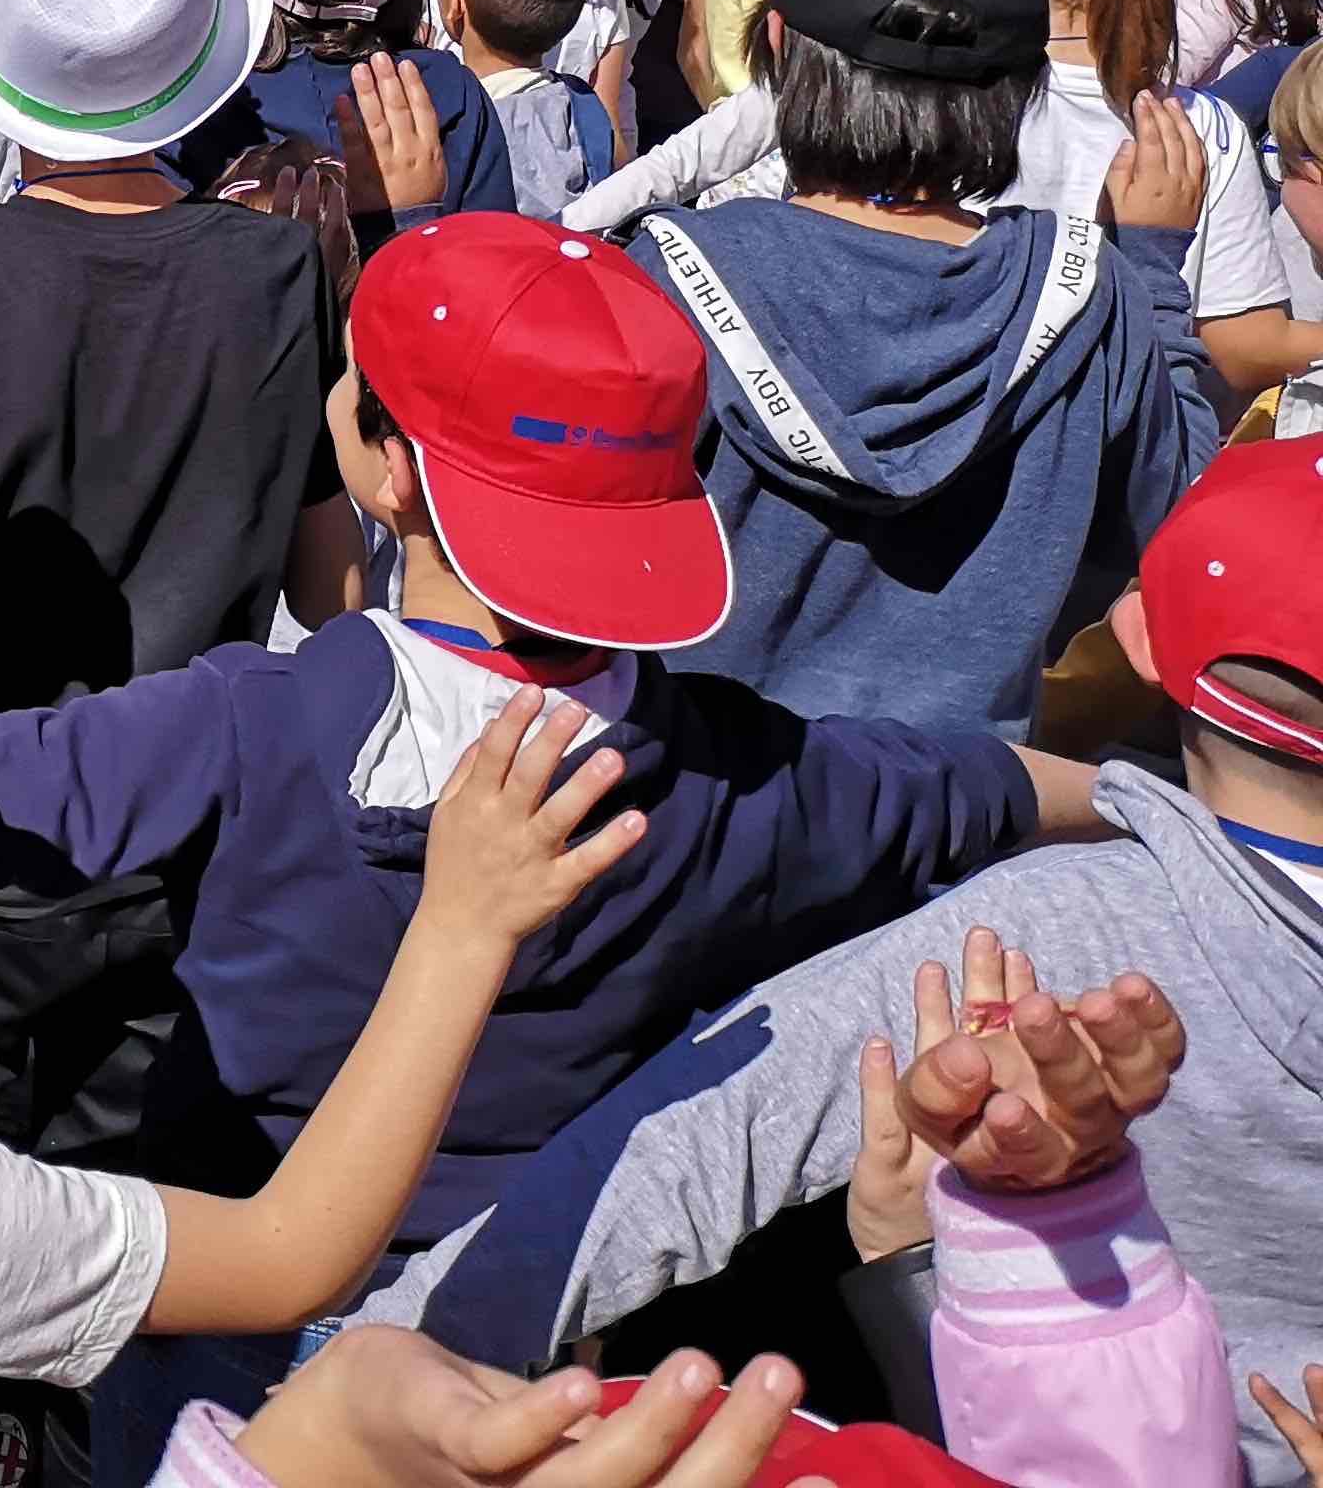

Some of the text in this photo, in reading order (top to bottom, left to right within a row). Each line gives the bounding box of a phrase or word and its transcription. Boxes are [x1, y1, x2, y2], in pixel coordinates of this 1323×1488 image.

[654, 230, 742, 335] ATHLETIC
[1057, 252, 1086, 297] BOY
[746, 368, 792, 418] BOY
